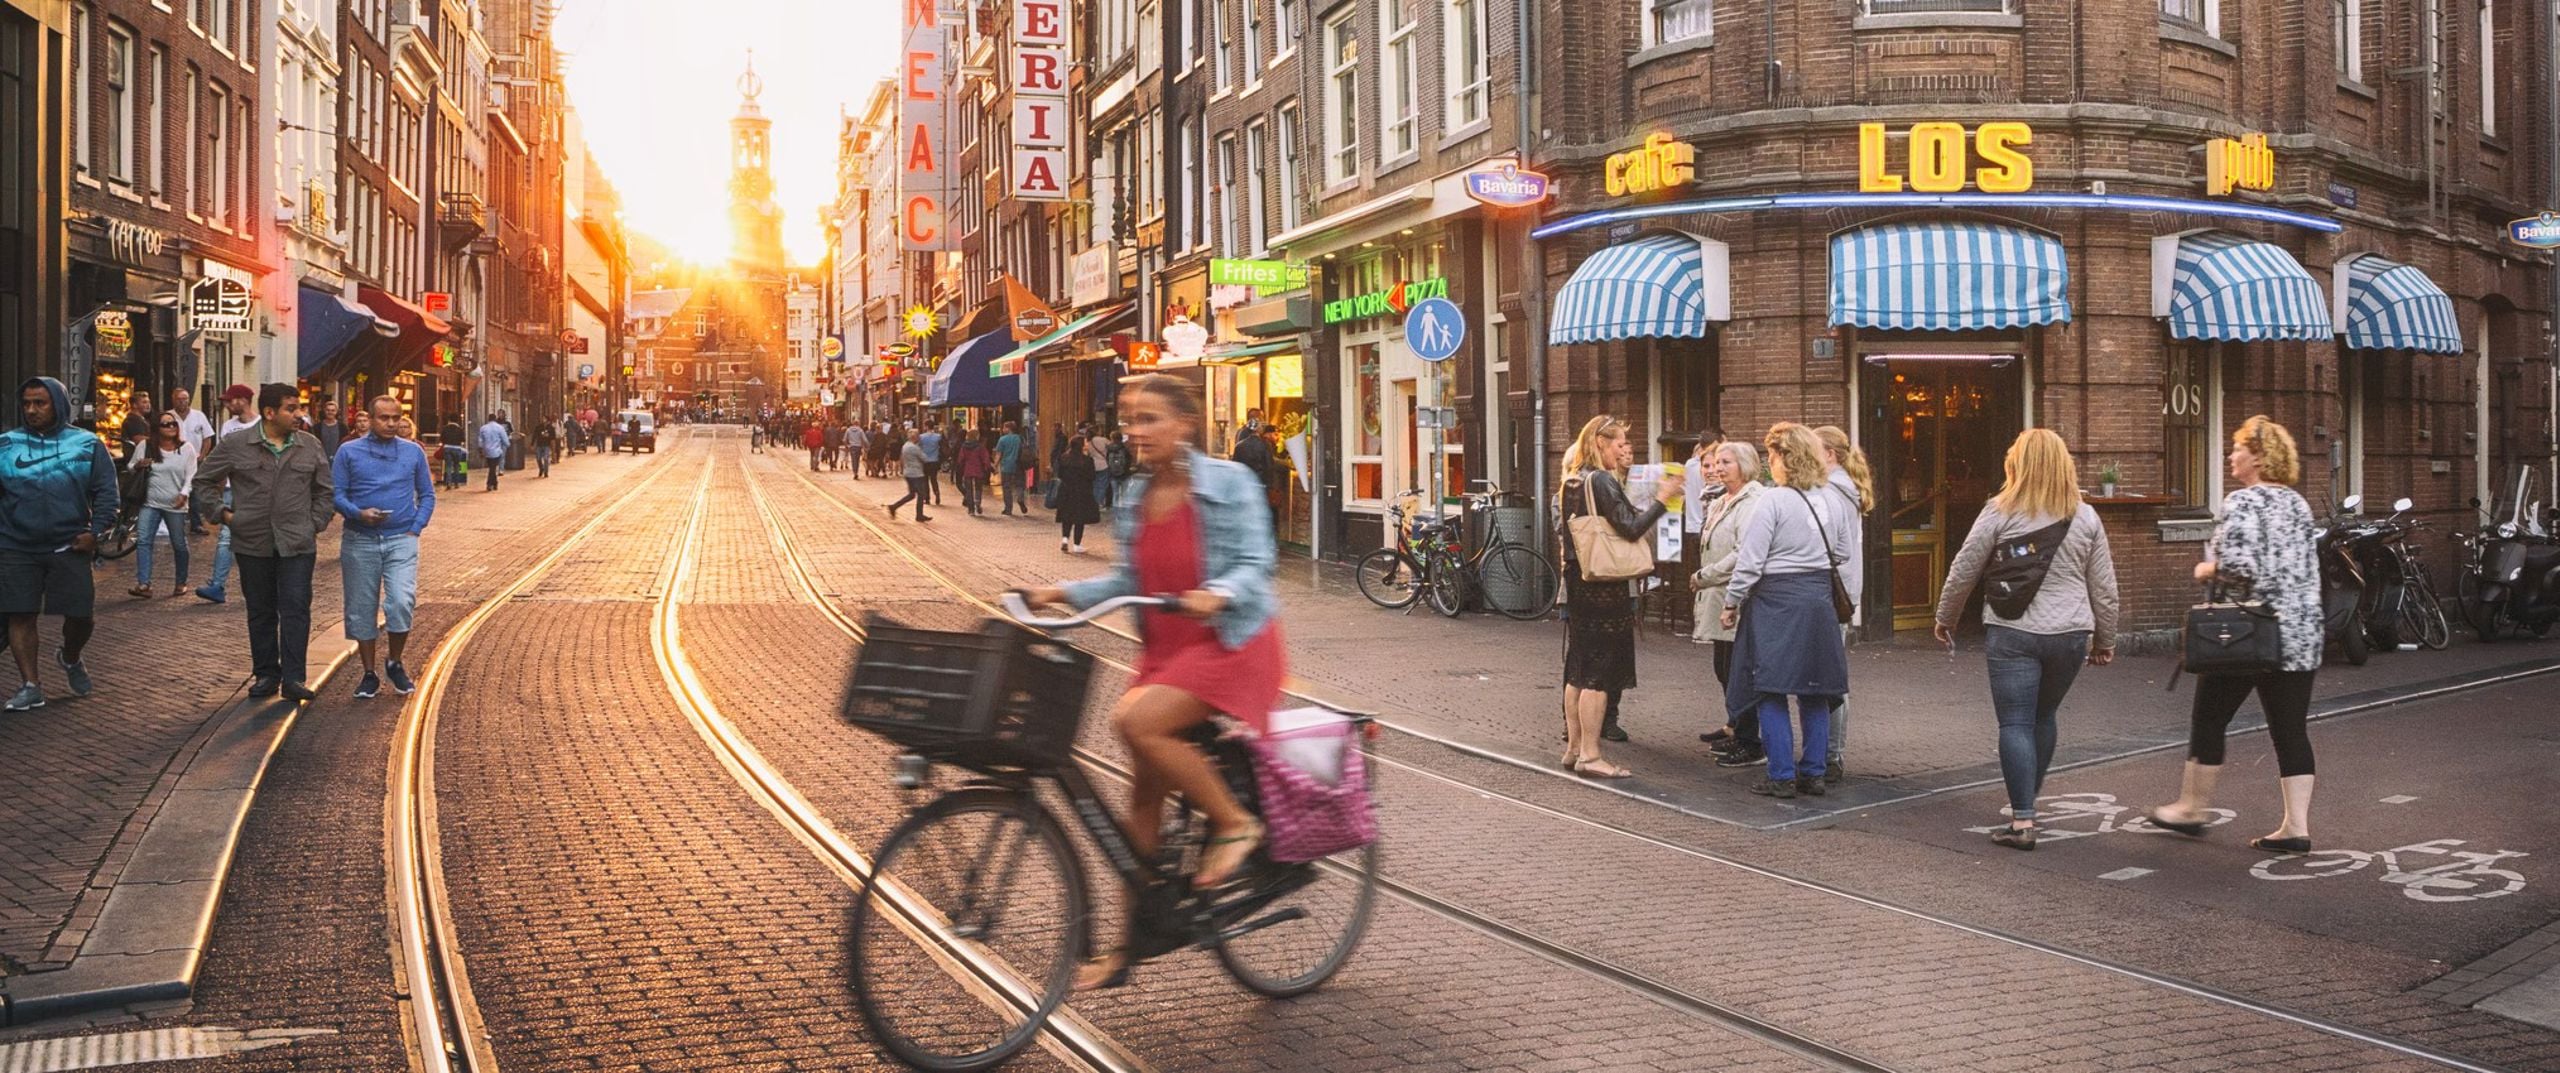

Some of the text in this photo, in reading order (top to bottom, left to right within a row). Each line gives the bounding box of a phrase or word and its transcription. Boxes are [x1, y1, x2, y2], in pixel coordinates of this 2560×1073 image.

[1859, 122, 2033, 193] LOS
[2218, 133, 2273, 196] pub
[1478, 179, 1539, 195] Bavaria
[109, 219, 163, 265] TATTOO
[1223, 263, 1278, 282] Frites
[1324, 277, 1448, 323] NEW YORK PIZZA
